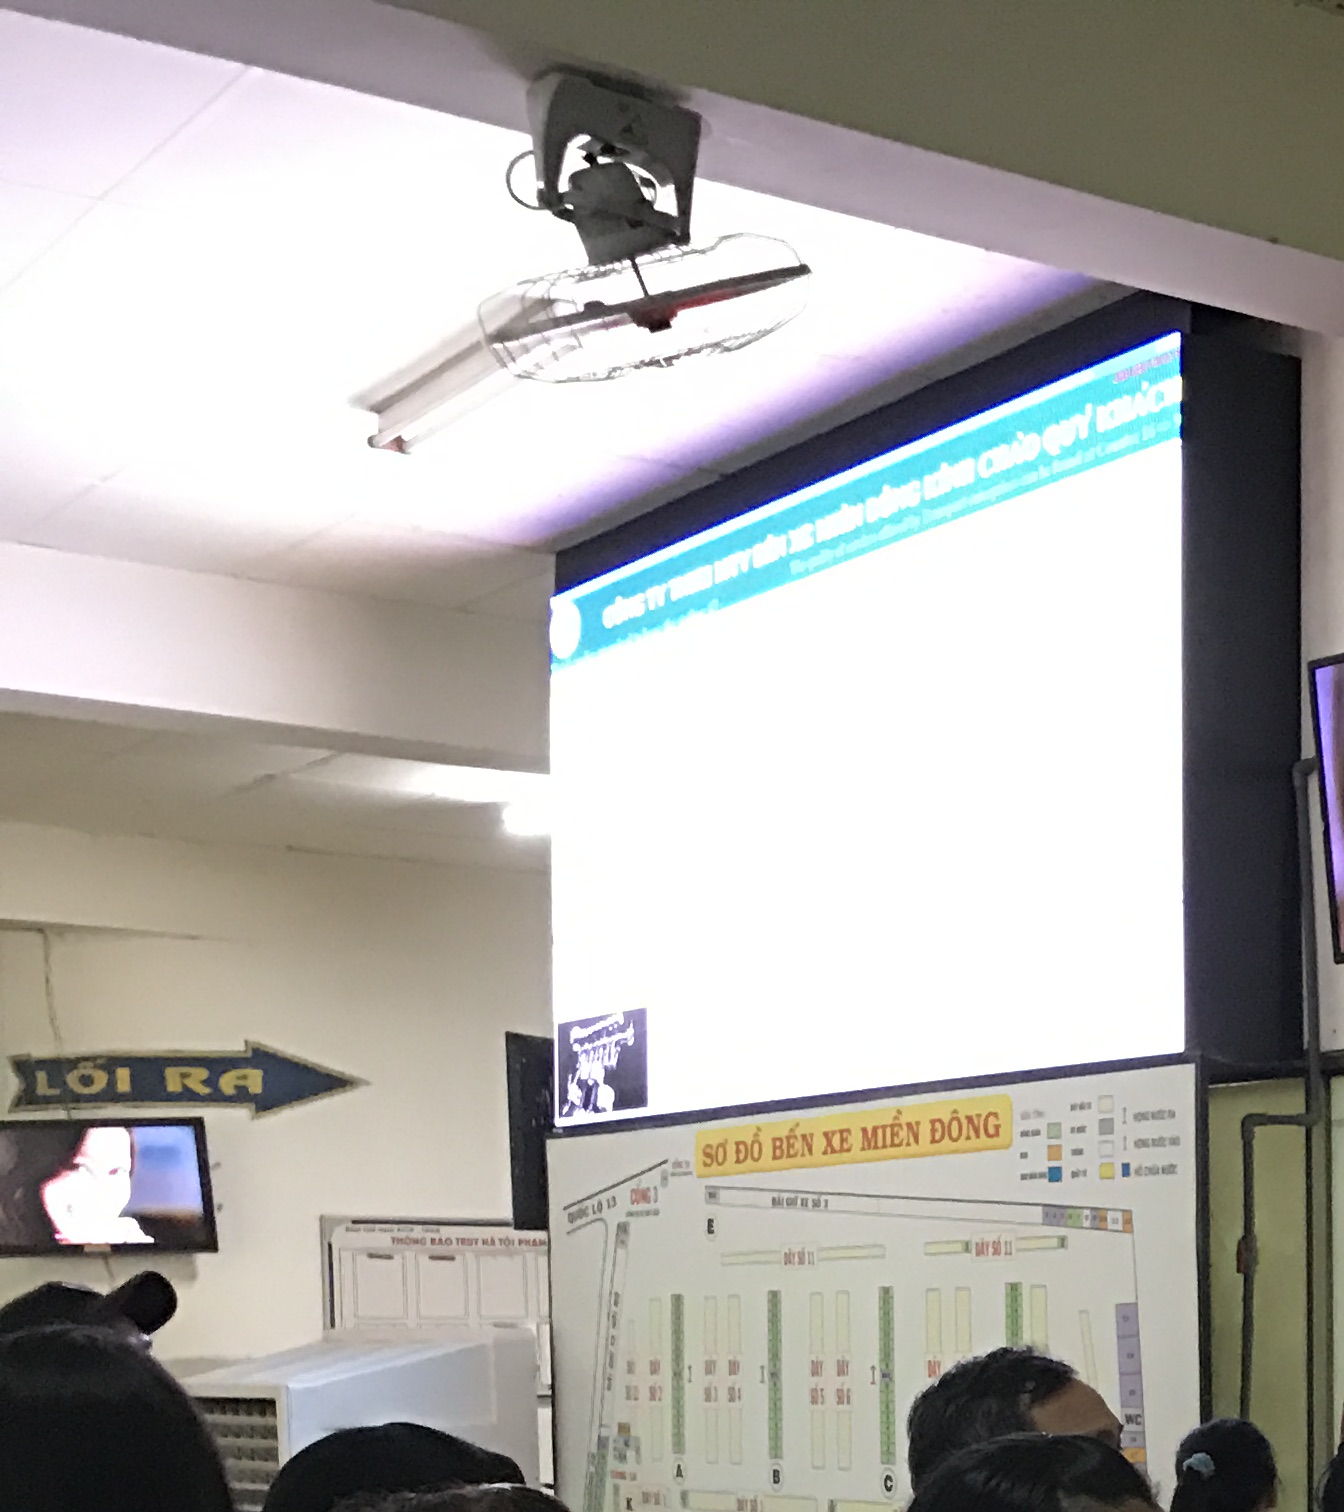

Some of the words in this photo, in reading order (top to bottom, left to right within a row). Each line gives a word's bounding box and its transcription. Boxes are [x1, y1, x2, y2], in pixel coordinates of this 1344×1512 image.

[34, 1057, 131, 1097] LỐI
[164, 1065, 264, 1097] RA
[702, 1138, 728, 1168] SƠ
[734, 1126, 763, 1164] ĐỒ
[772, 1122, 814, 1161] BẾN
[822, 1128, 852, 1155] XE
[860, 1109, 921, 1152] MIỀN
[930, 1108, 1001, 1144] ĐÔNG
[606, 1196, 617, 1209] 13
[708, 1218, 714, 1234] E
[391, 1235, 426, 1246] THÔNG
[1125, 1413, 1142, 1425] WC
[676, 1464, 683, 1479] A
[772, 1469, 780, 1485] B
[884, 1474, 893, 1492] C
